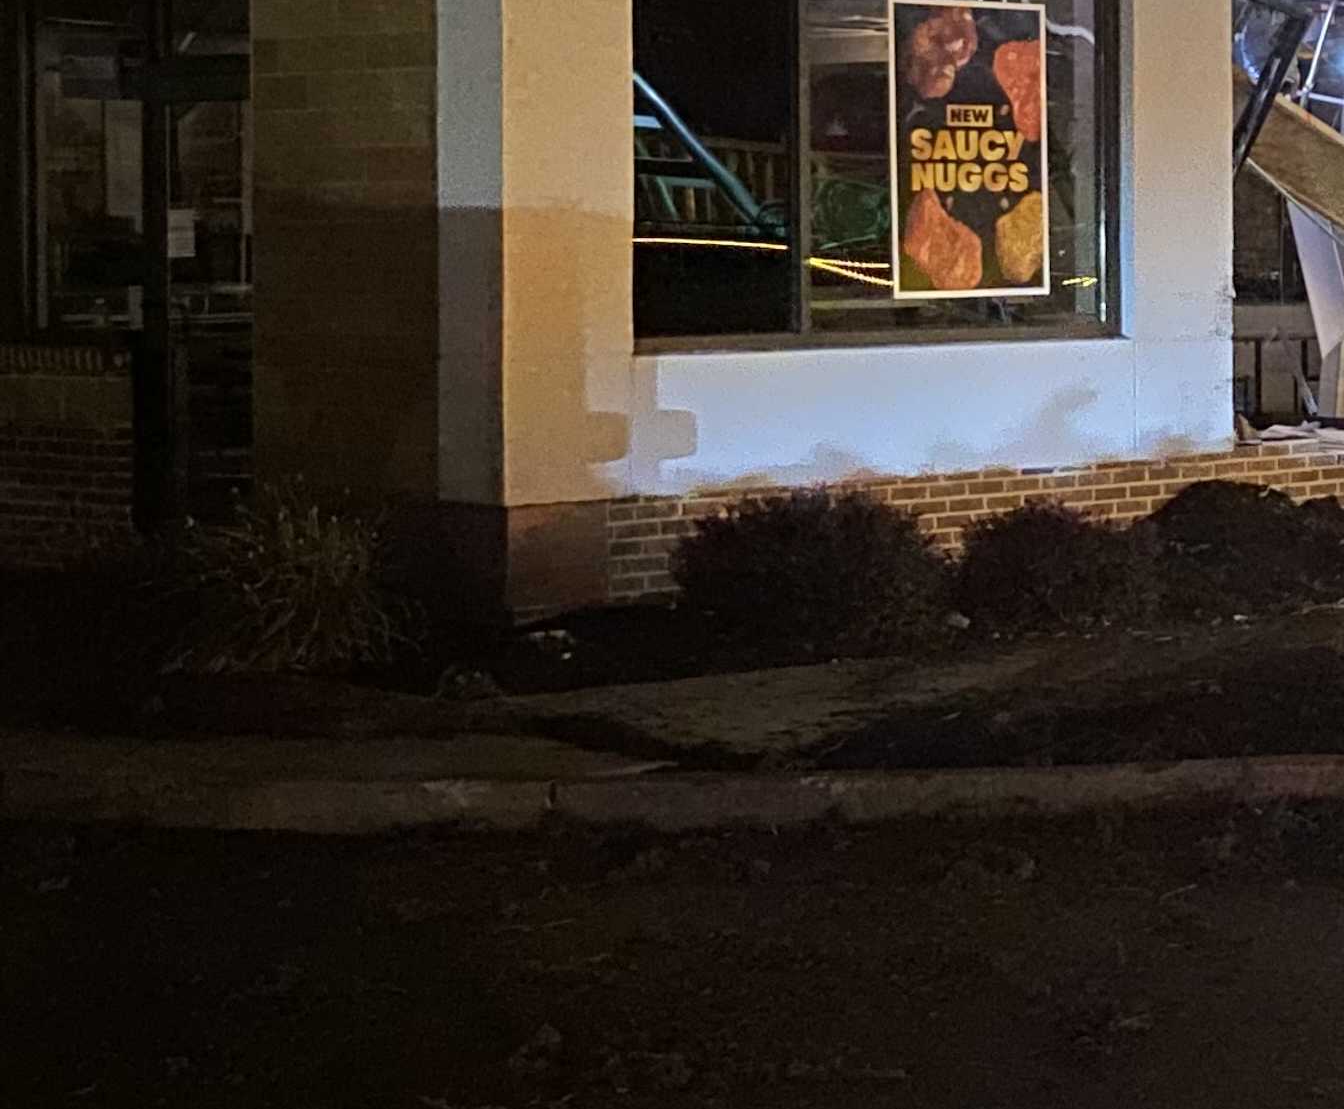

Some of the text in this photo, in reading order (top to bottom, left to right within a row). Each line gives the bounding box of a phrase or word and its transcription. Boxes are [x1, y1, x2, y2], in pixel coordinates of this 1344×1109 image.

[950, 108, 989, 124] NEW
[911, 128, 1025, 162] SAUCY
[911, 162, 1029, 192] NUGGS
